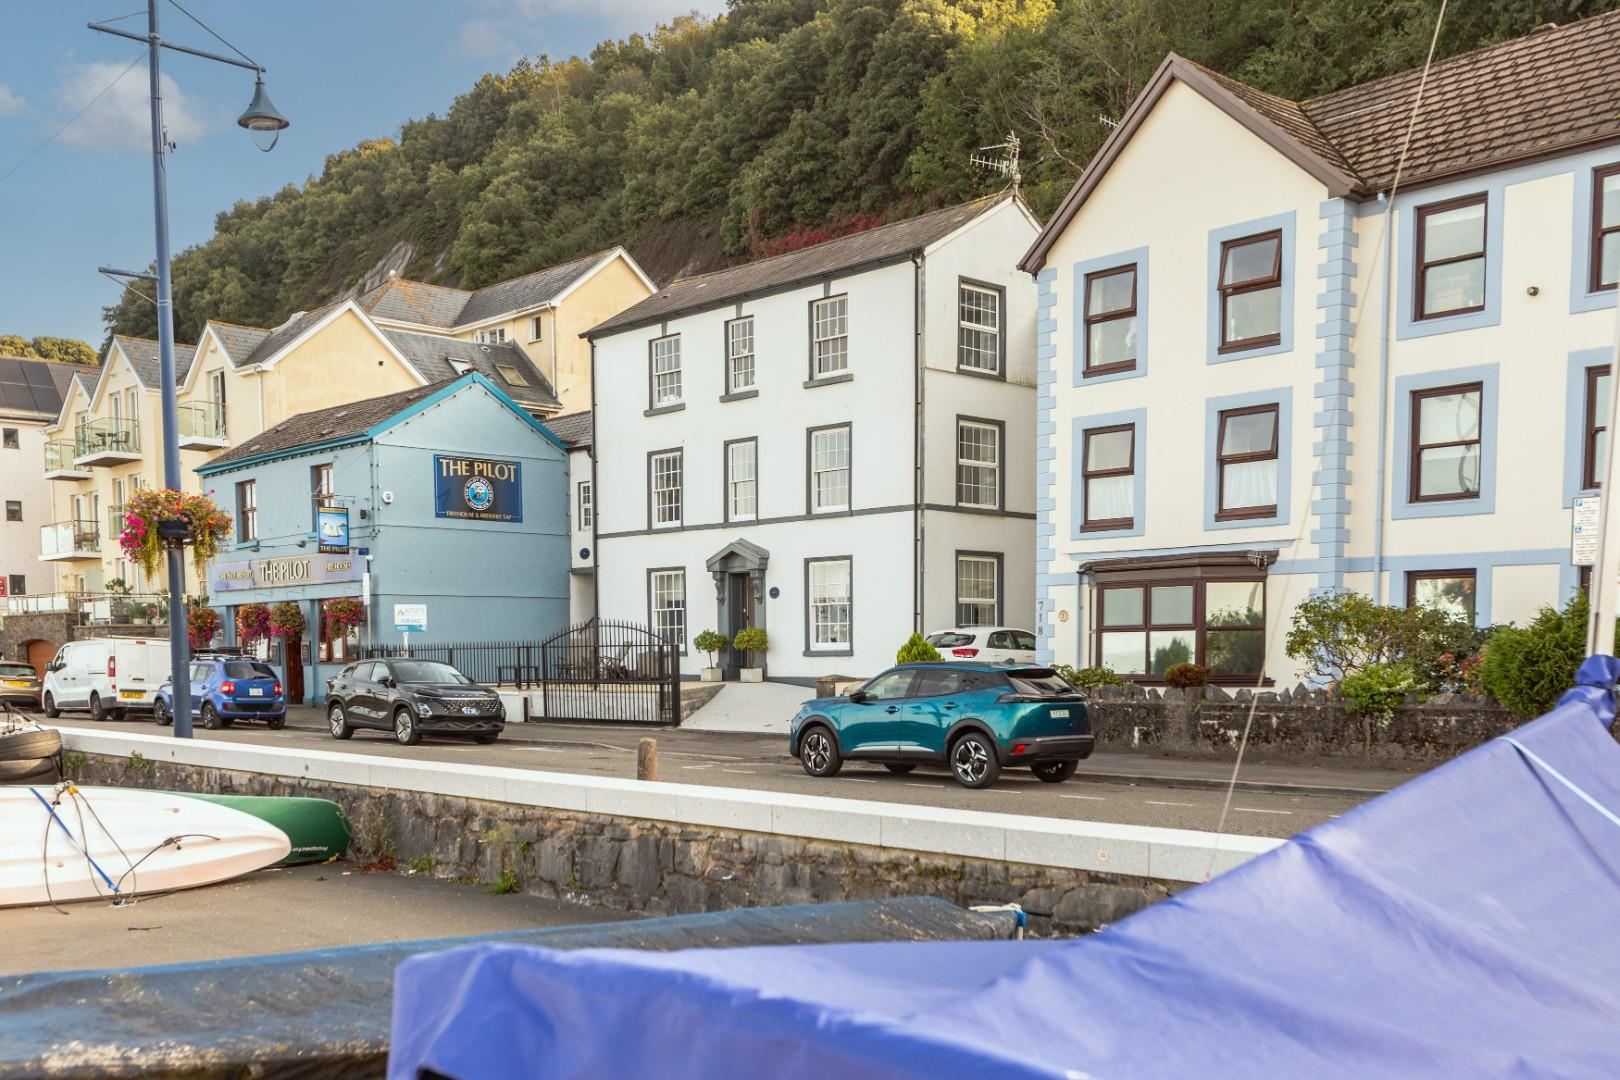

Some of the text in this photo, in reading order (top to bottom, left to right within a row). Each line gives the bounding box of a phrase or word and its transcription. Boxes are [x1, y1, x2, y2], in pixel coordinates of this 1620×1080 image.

[440, 459, 517, 483] THE PILOT
[259, 560, 311, 582] THE PILOT
